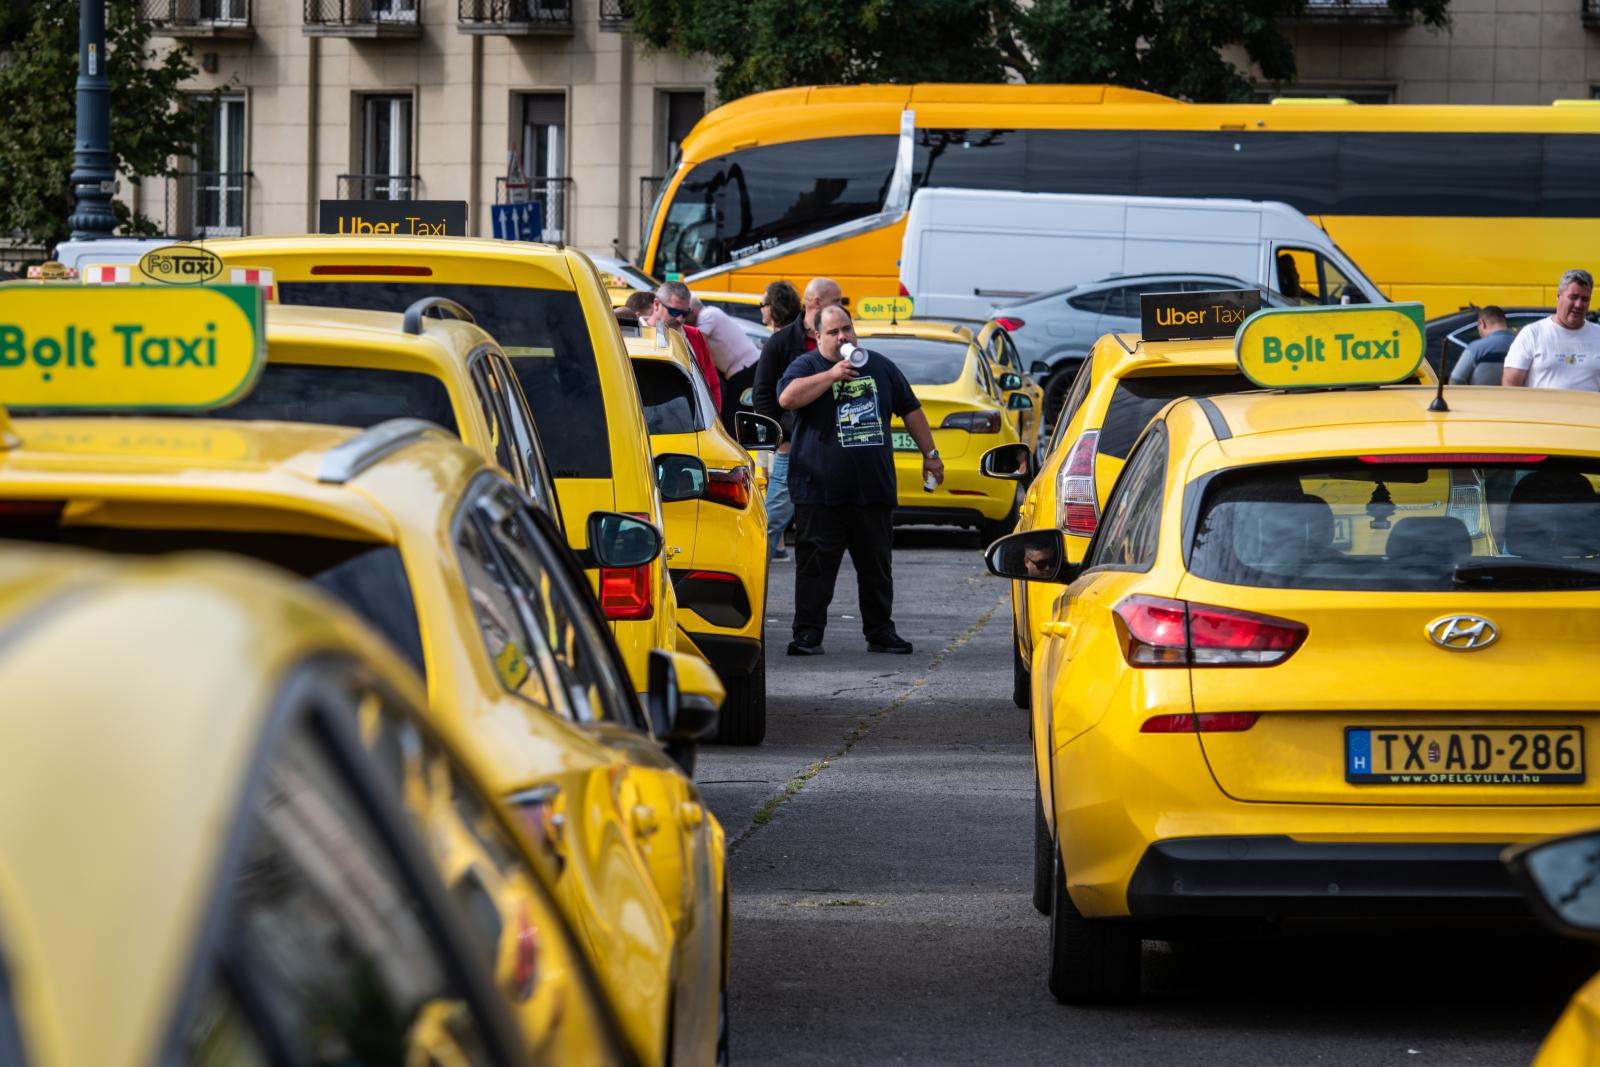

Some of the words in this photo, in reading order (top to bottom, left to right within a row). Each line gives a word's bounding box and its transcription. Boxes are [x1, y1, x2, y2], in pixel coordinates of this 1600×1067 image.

[338, 216, 399, 236] Uber
[405, 217, 446, 237] Taxi
[864, 303, 884, 315] Bolt
[887, 304, 907, 313] Taxi
[1155, 306, 1207, 326] Uber
[1211, 304, 1246, 324] Taxi
[0, 324, 96, 382] Bolt
[112, 322, 217, 368] Taxi
[1262, 334, 1326, 371] Bolt
[1335, 329, 1400, 361] Taxi
[1354, 756, 1366, 769] H
[1377, 734, 1425, 770] TX
[1390, 774, 1541, 783] www.OPELGYULAI.hu
